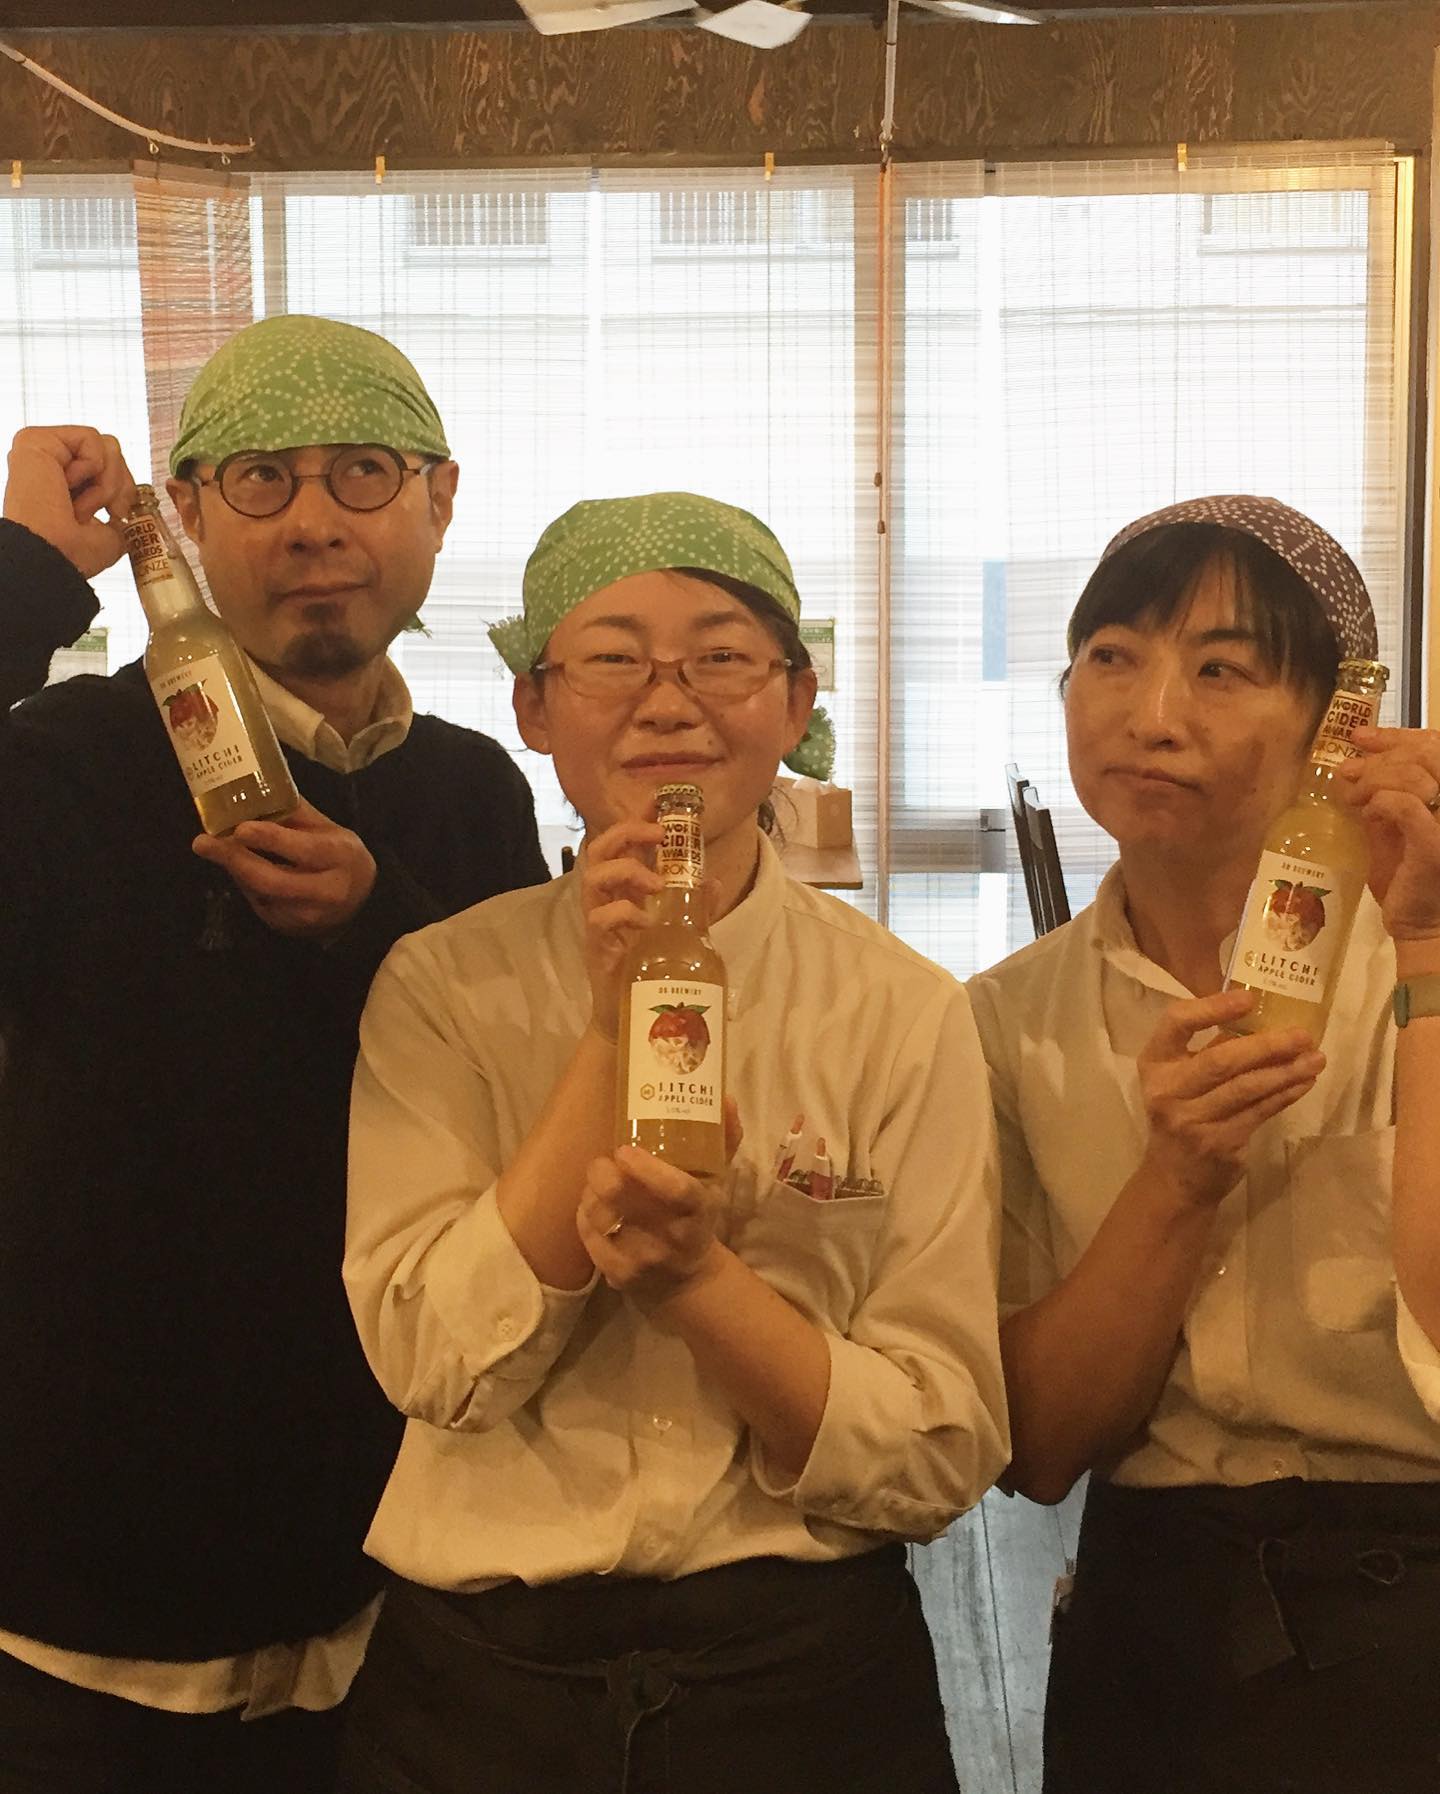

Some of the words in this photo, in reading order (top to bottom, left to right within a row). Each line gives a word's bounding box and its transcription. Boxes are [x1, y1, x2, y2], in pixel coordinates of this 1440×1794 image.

[132, 533, 161, 549] DER
[1332, 699, 1371, 718] WORLD
[1322, 724, 1353, 740] AWAR
[192, 744, 240, 771] LITCHI
[1261, 952, 1318, 976] LITCHI
[1257, 963, 1285, 980] APPLE
[1288, 972, 1316, 986] CIDER
[659, 1081, 713, 1097] LITCHI
[689, 1095, 713, 1107] CIDER
